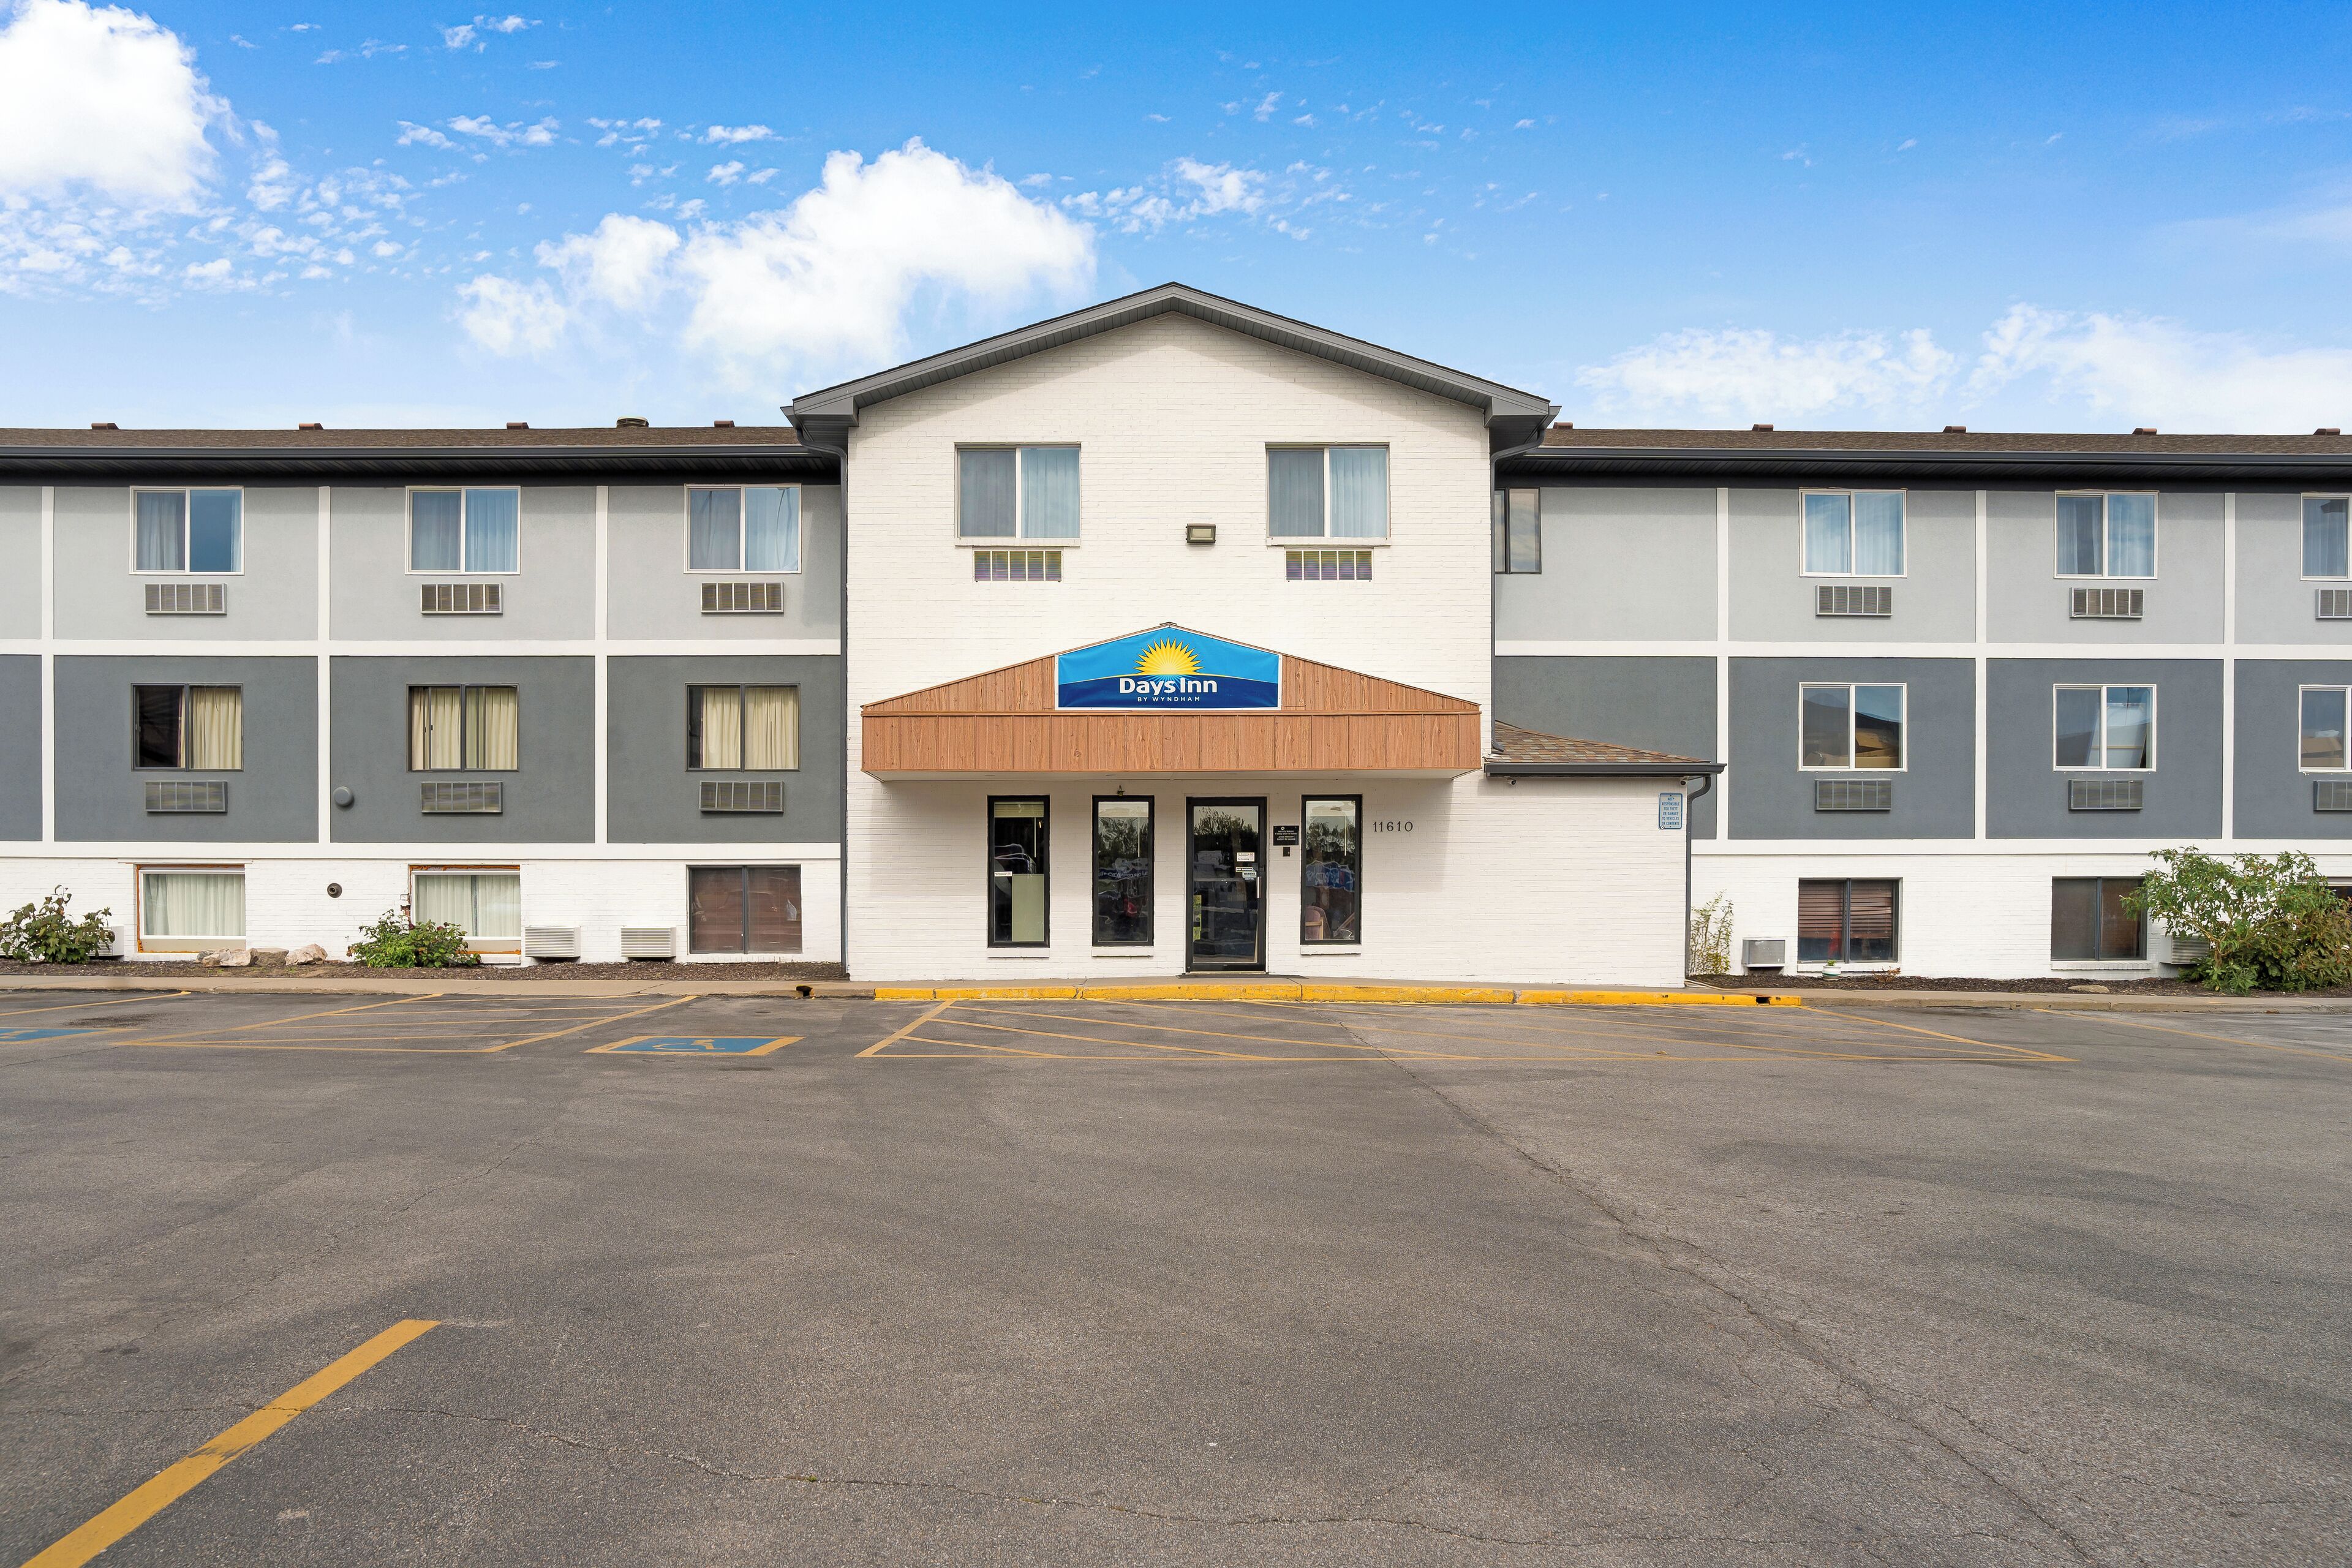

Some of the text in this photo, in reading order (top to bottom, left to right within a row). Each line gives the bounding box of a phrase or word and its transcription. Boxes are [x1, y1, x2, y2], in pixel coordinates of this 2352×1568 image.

[1120, 677, 1217, 696] Days Inn
[1373, 821, 1413, 832] 11610
